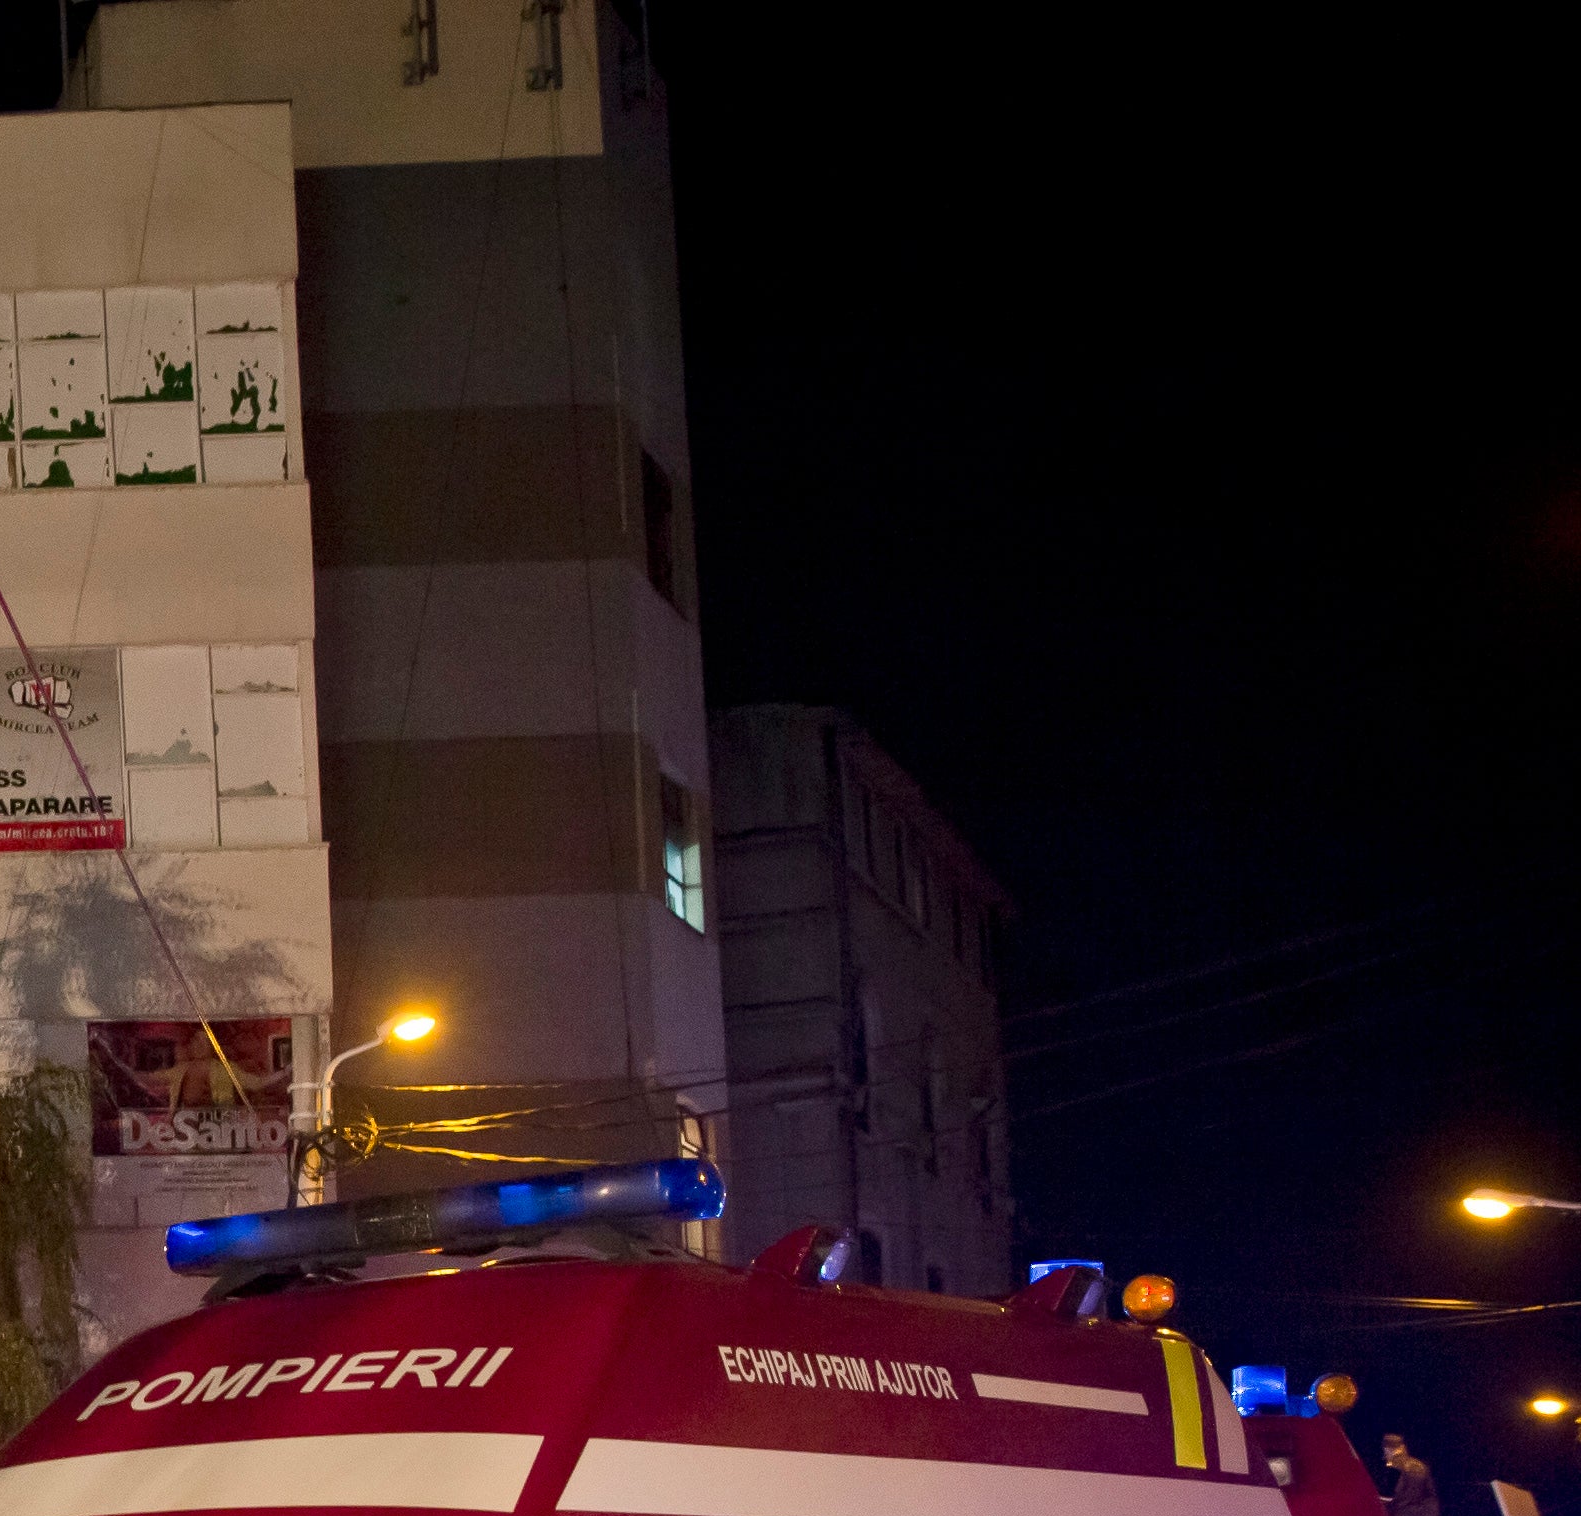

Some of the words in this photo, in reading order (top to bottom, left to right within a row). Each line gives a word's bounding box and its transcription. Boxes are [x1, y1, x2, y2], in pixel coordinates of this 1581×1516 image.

[39, 664, 82, 680] CLUB
[59, 712, 100, 732] EAM
[77, 1346, 514, 1422] POMPIERII
[719, 1345, 814, 1389] ECHIPAJ
[820, 1354, 873, 1394] PRIM
[876, 1361, 958, 1400] AJUTOR
